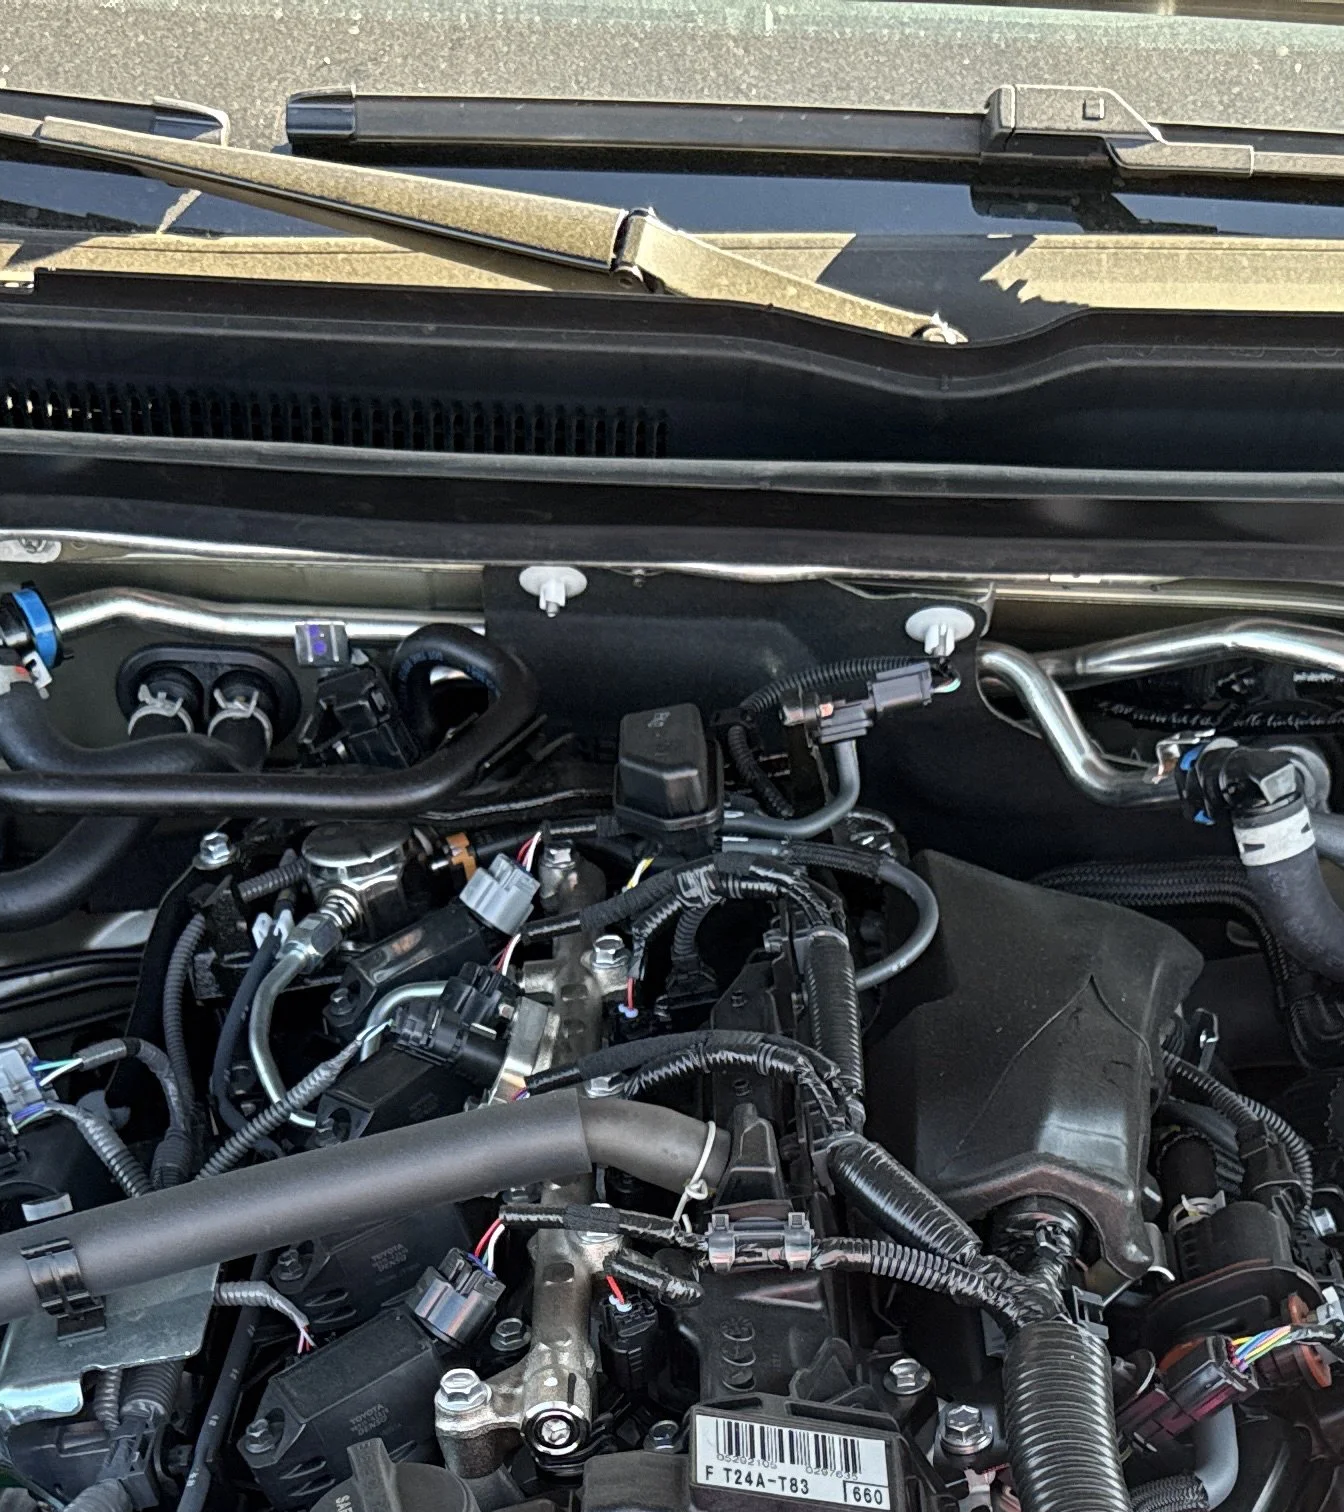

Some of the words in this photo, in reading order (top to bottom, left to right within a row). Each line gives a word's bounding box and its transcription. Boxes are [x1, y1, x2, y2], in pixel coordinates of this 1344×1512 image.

[706, 1465, 714, 1481] F
[723, 1467, 810, 1495] T24A-T83
[852, 1486, 883, 1506] 660
